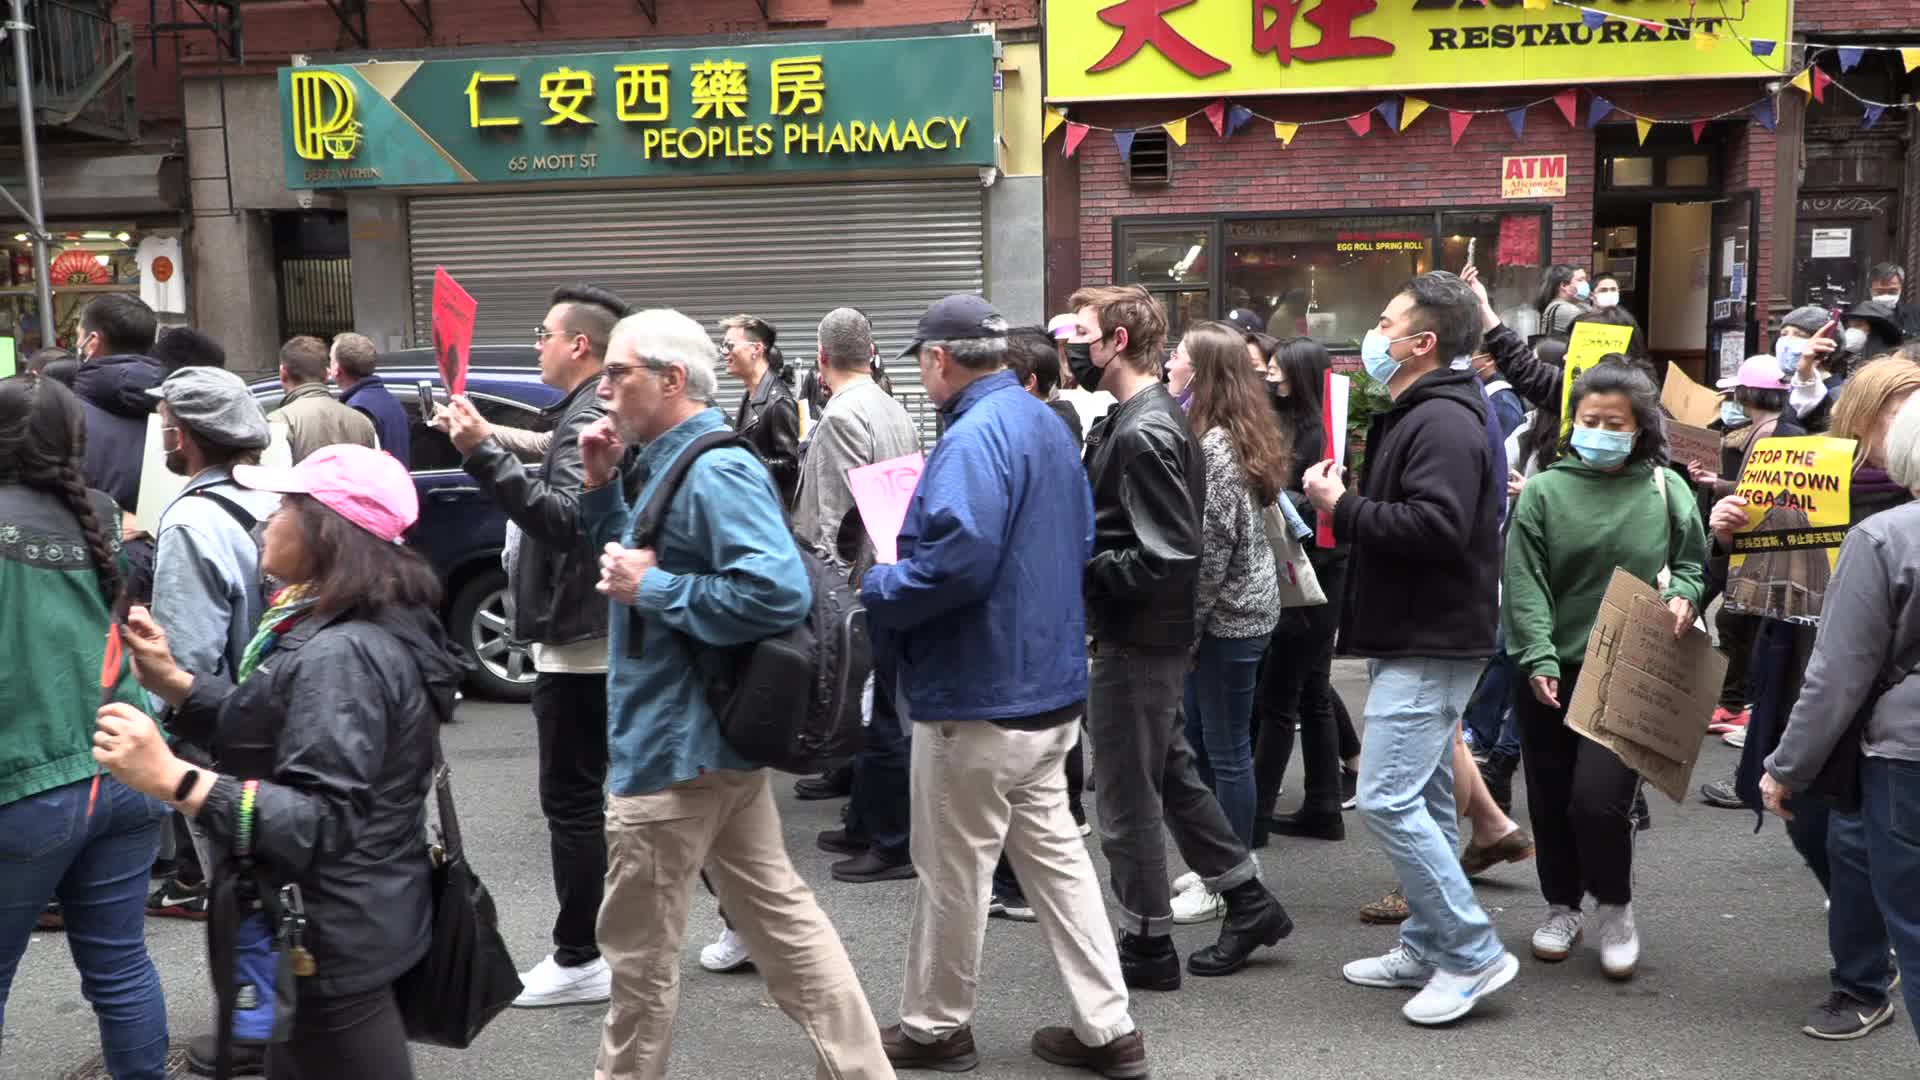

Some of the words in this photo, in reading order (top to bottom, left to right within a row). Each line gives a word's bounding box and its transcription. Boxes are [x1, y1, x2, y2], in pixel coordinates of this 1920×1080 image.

[1428, 18, 1722, 51] RESTAURANT
[464, 55, 824, 128] 仁安西藥房
[643, 123, 774, 160] PEOPLES
[784, 116, 969, 154] PHARMACY
[508, 157, 528, 171] 65
[532, 154, 574, 170] MOTT
[579, 152, 598, 169] ST
[1505, 157, 1565, 179] ATM
[1336, 243, 1353, 252] EGG
[1354, 242, 1373, 251] ROLL
[1375, 242, 1402, 251] SPRING
[1404, 241, 1424, 250] ROLL
[1748, 450, 1782, 465] STOP
[1785, 449, 1817, 468] THE
[1778, 491, 1818, 513] JAIL
